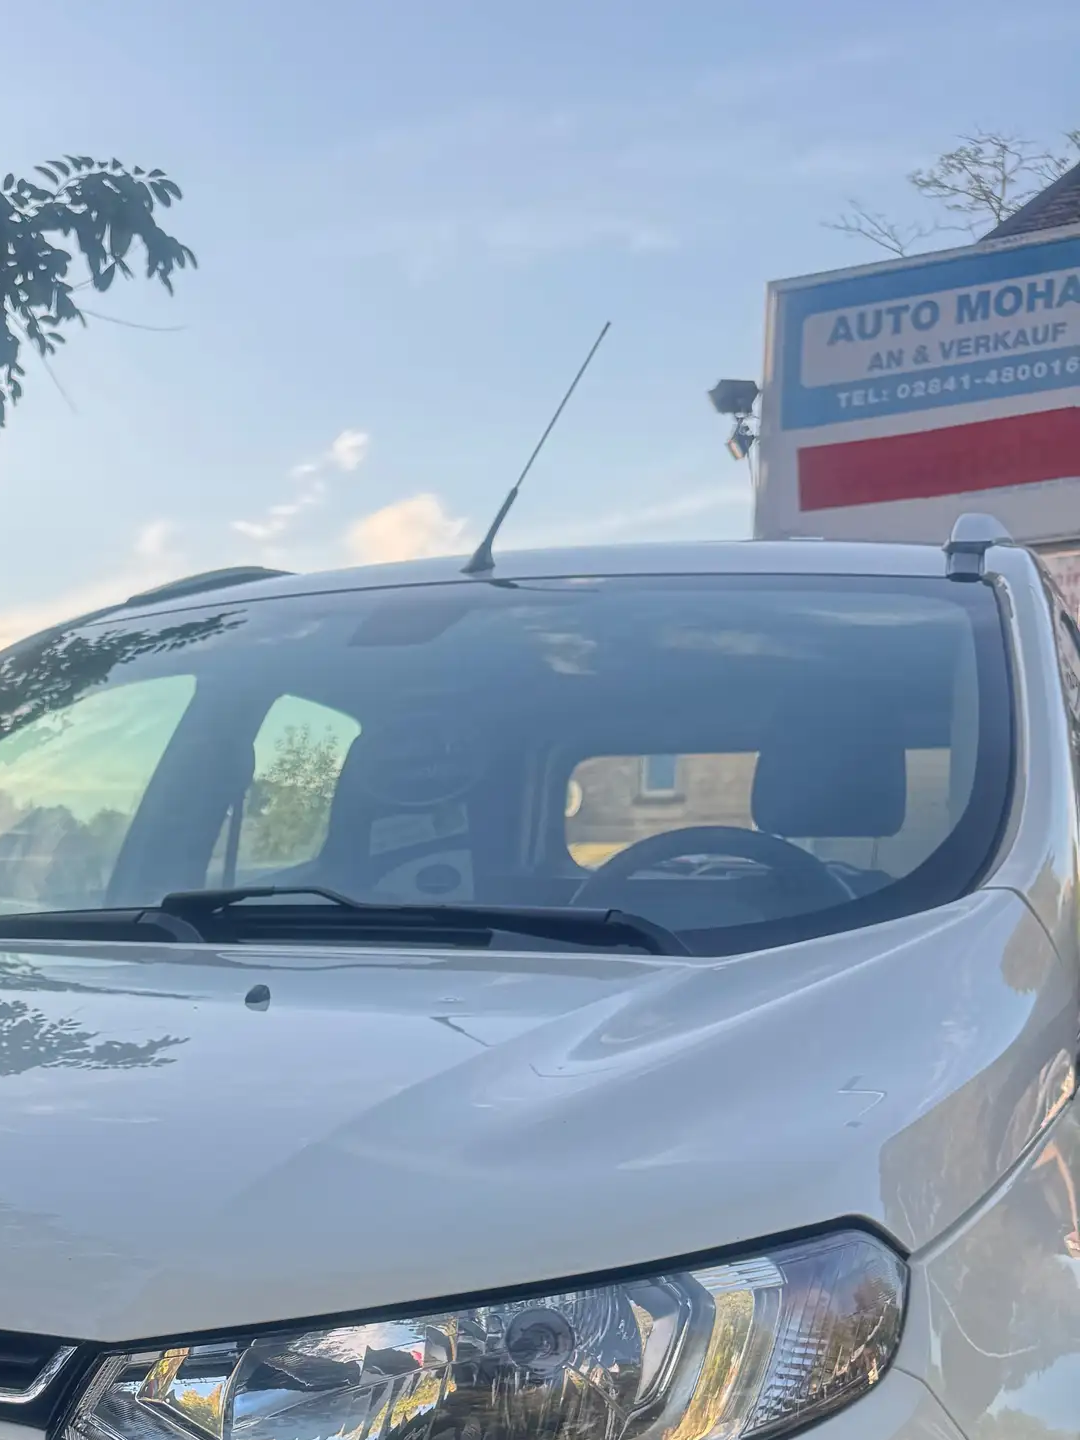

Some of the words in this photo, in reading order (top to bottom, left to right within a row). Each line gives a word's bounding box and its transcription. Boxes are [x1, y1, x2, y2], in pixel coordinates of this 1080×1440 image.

[826, 299, 940, 347] AUTO
[867, 347, 904, 372] AN
[911, 344, 931, 366] &
[939, 321, 1068, 360] VERKAUF
